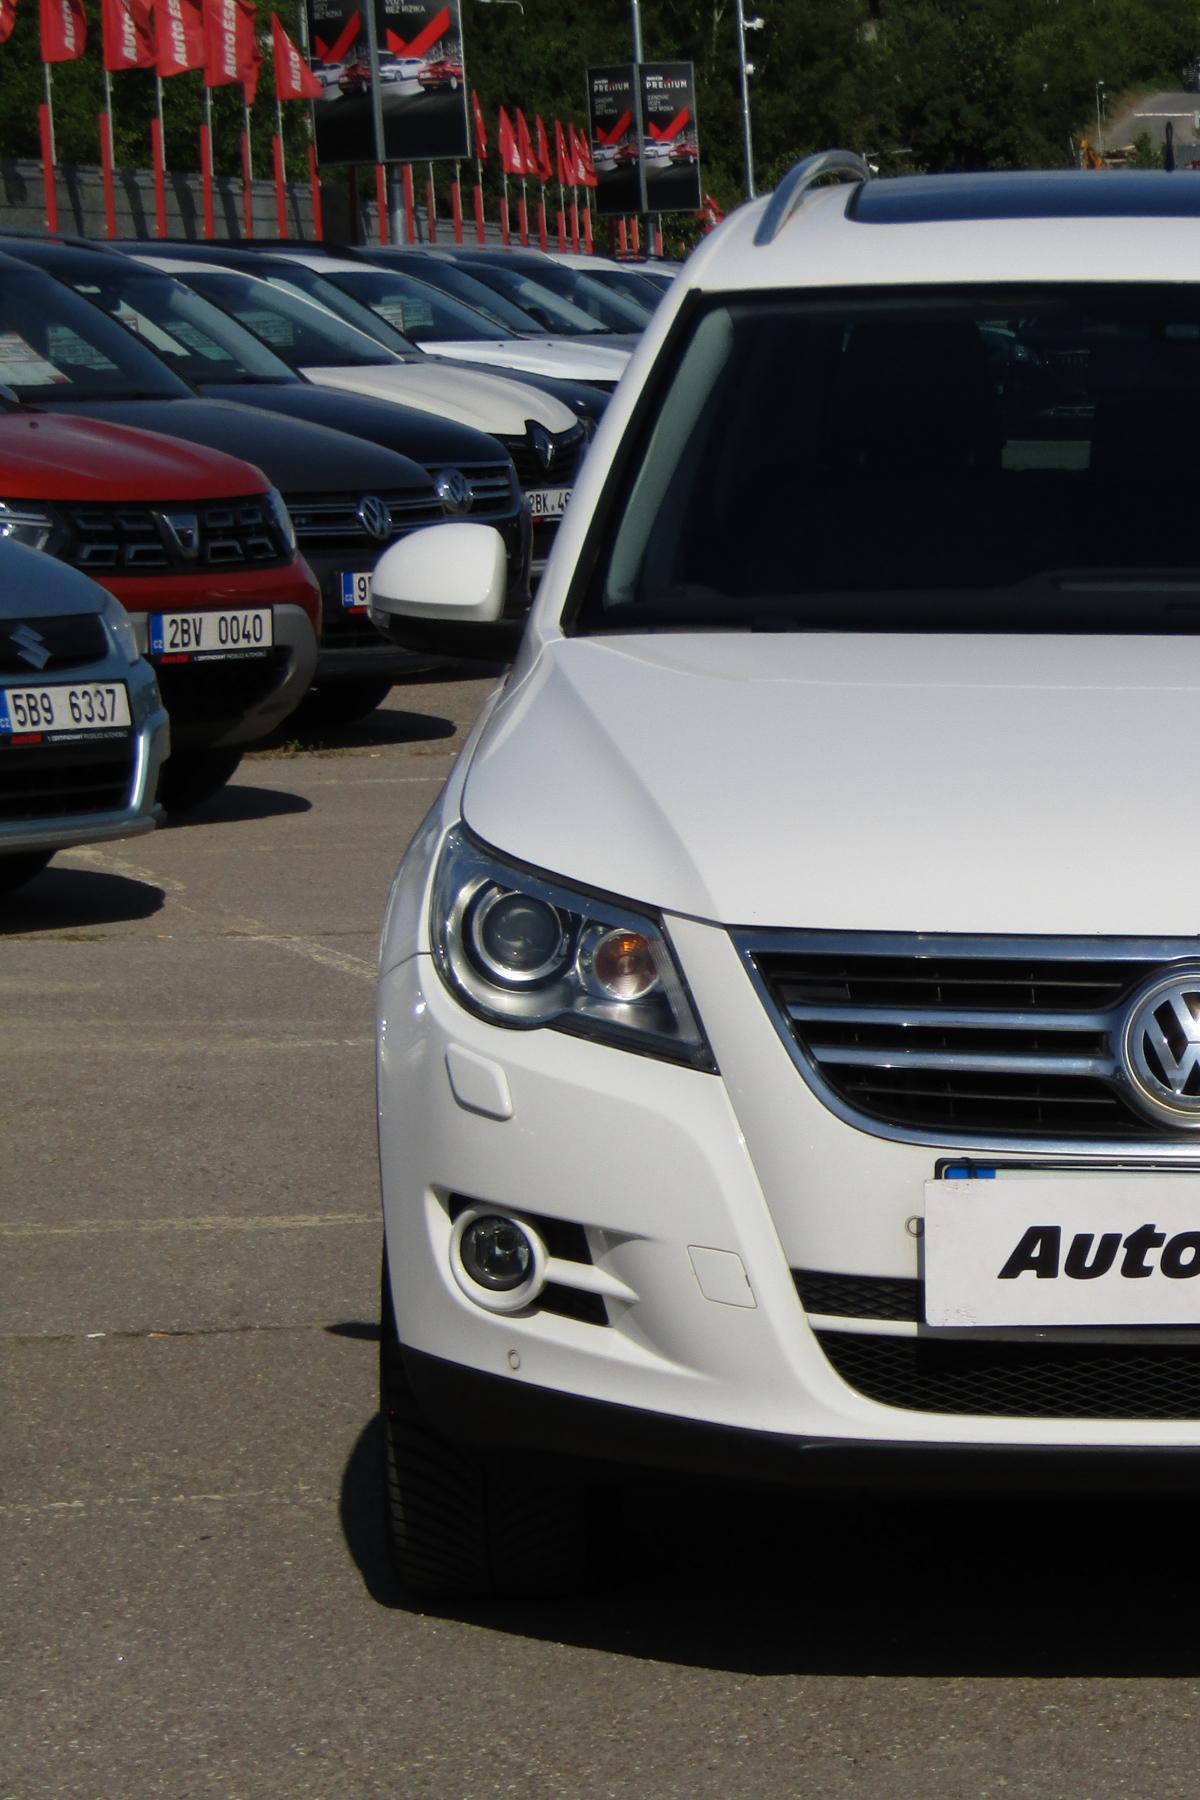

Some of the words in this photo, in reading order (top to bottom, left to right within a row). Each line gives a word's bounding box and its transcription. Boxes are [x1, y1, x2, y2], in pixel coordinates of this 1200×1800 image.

[167, 0, 183, 18] ES
[171, 20, 189, 67] Auto
[224, 33, 238, 78] Auto
[288, 51, 302, 92] Auto
[645, 80, 688, 89] PREMIUM
[169, 616, 203, 649] 2BV
[218, 614, 263, 646] 0040
[12, 693, 54, 727] 5B9
[68, 689, 116, 723] 6337
